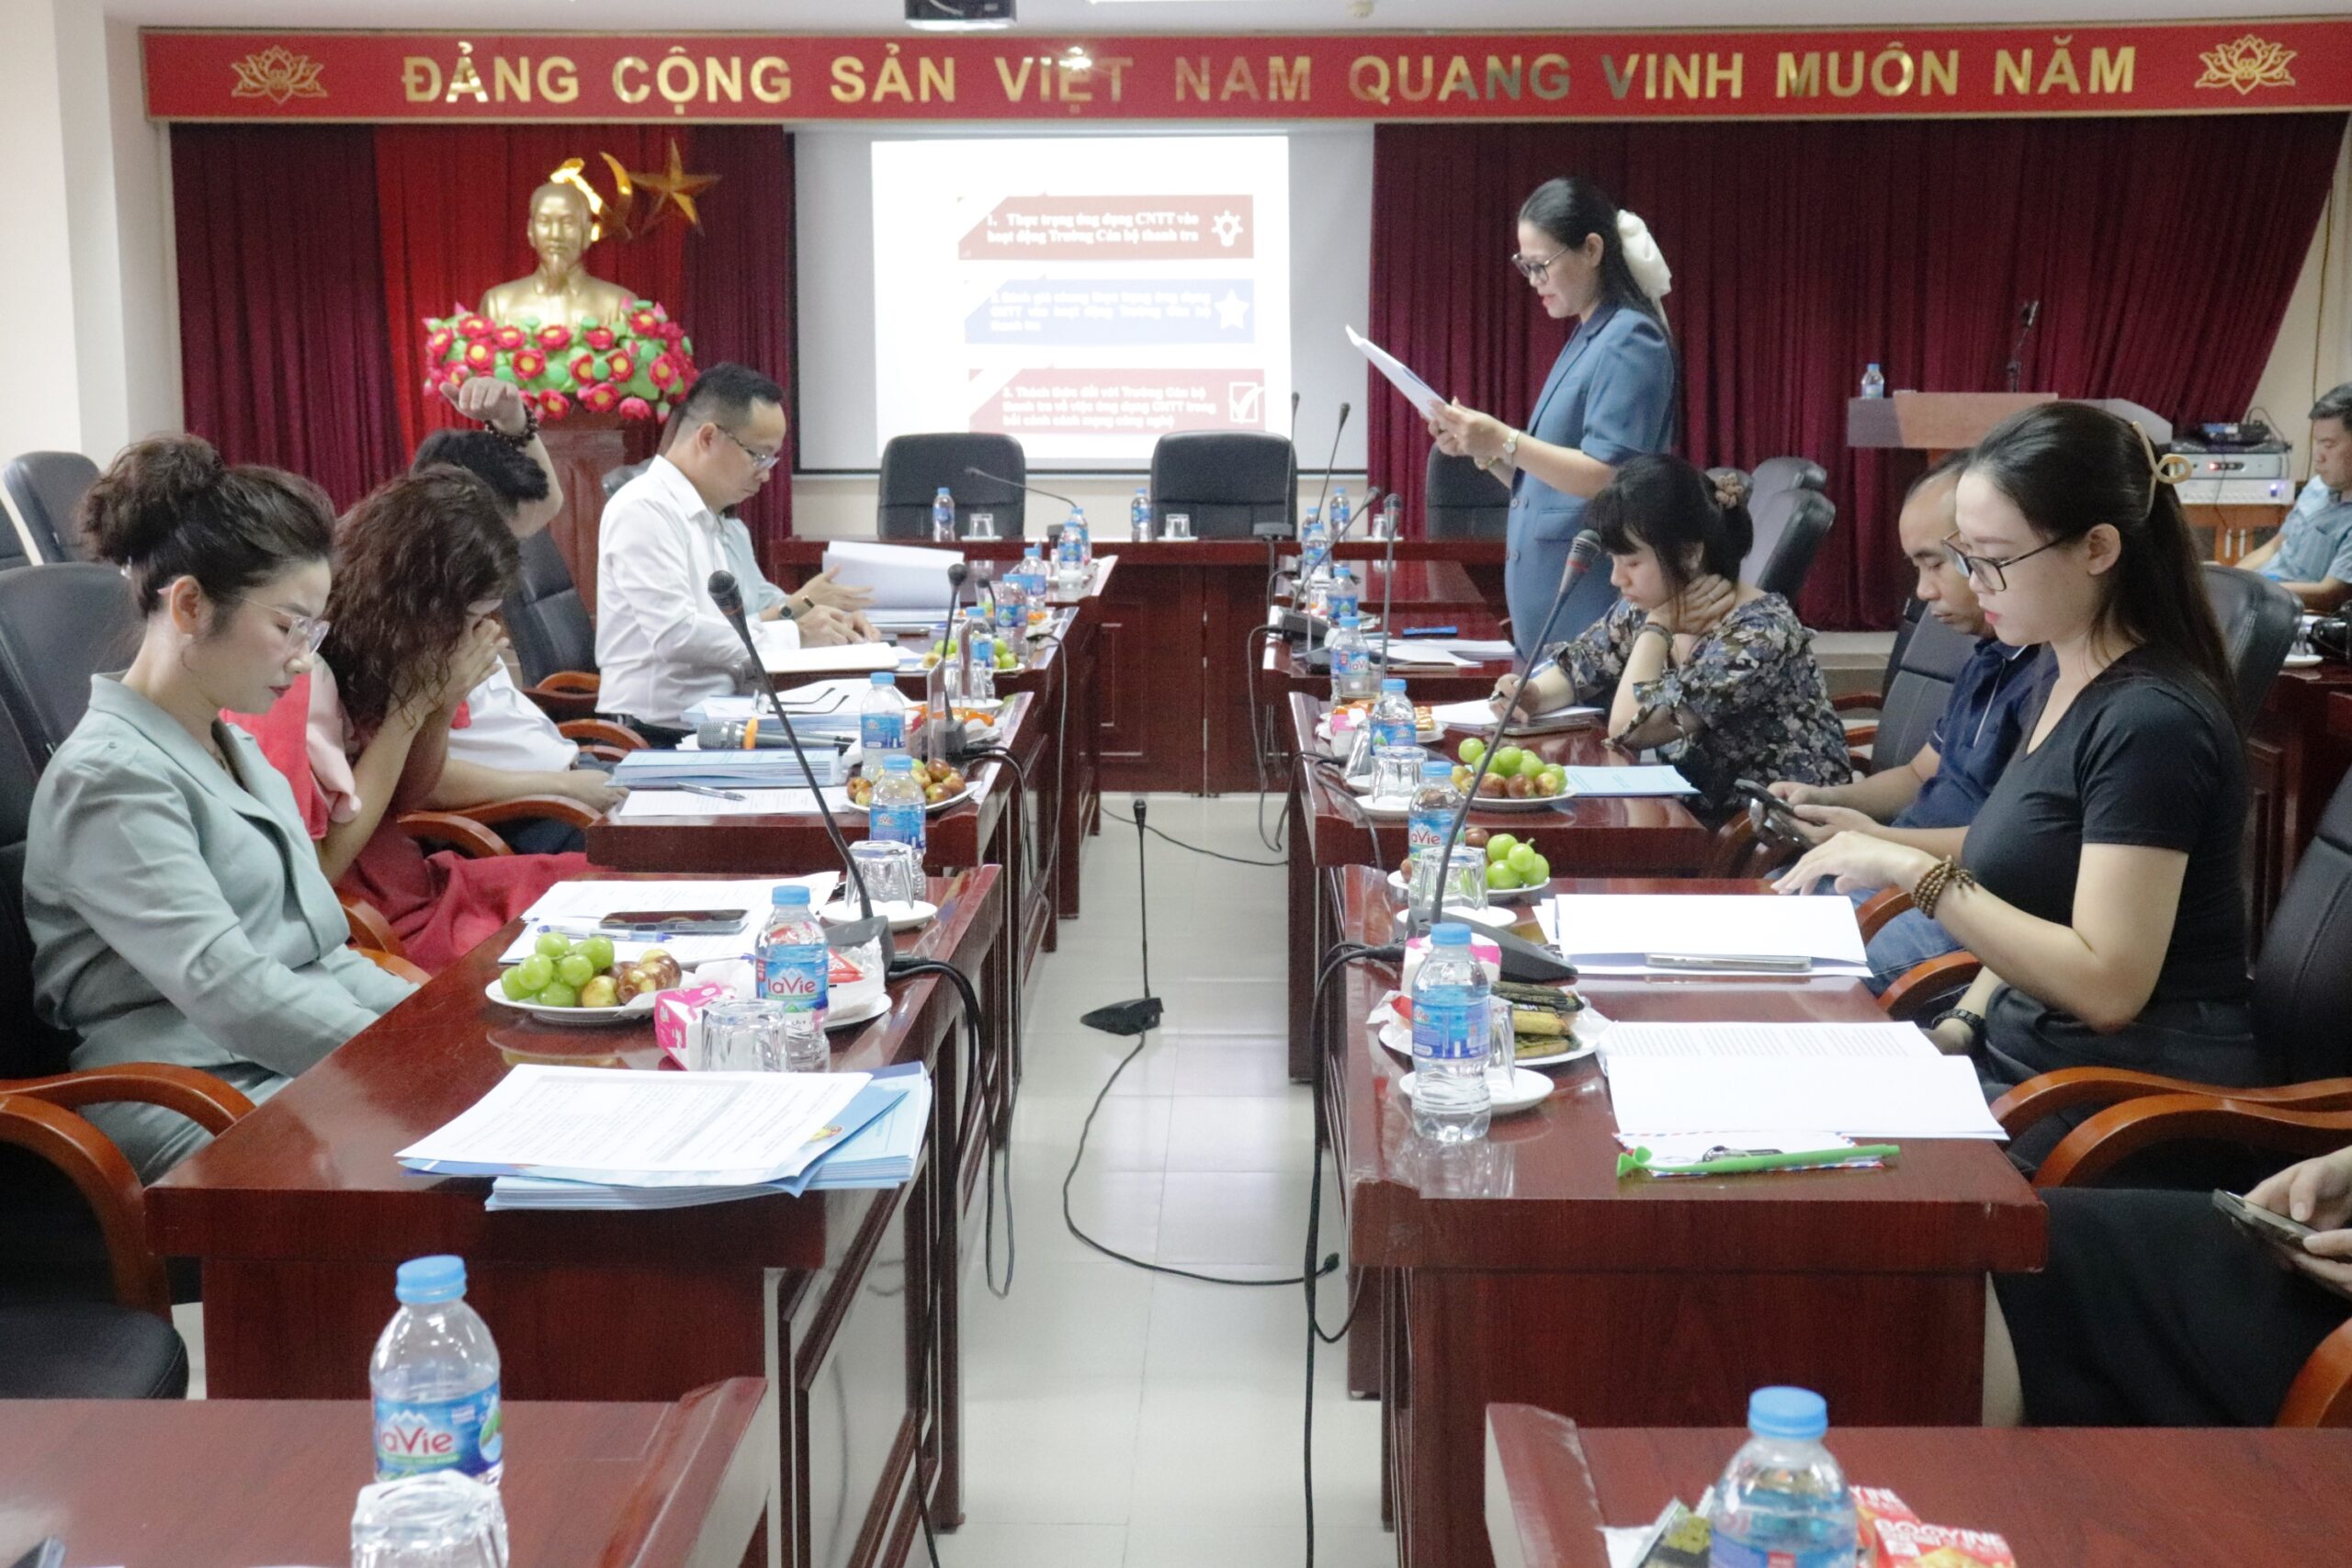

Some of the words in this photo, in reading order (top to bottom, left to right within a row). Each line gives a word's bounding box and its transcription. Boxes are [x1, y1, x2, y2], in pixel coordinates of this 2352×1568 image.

[401, 41, 580, 103] ĐẢNG
[612, 46, 792, 115] CỘNG
[830, 43, 955, 103] SẢN
[994, 46, 1133, 114] VIỆT
[1175, 56, 1311, 103] NAM
[1348, 53, 1572, 106] QUANG
[1601, 52, 1744, 99] VINH
[1776, 42, 1960, 98] MUÔN
[1994, 34, 2136, 95] NĂM
[1411, 829, 1441, 845] aVie
